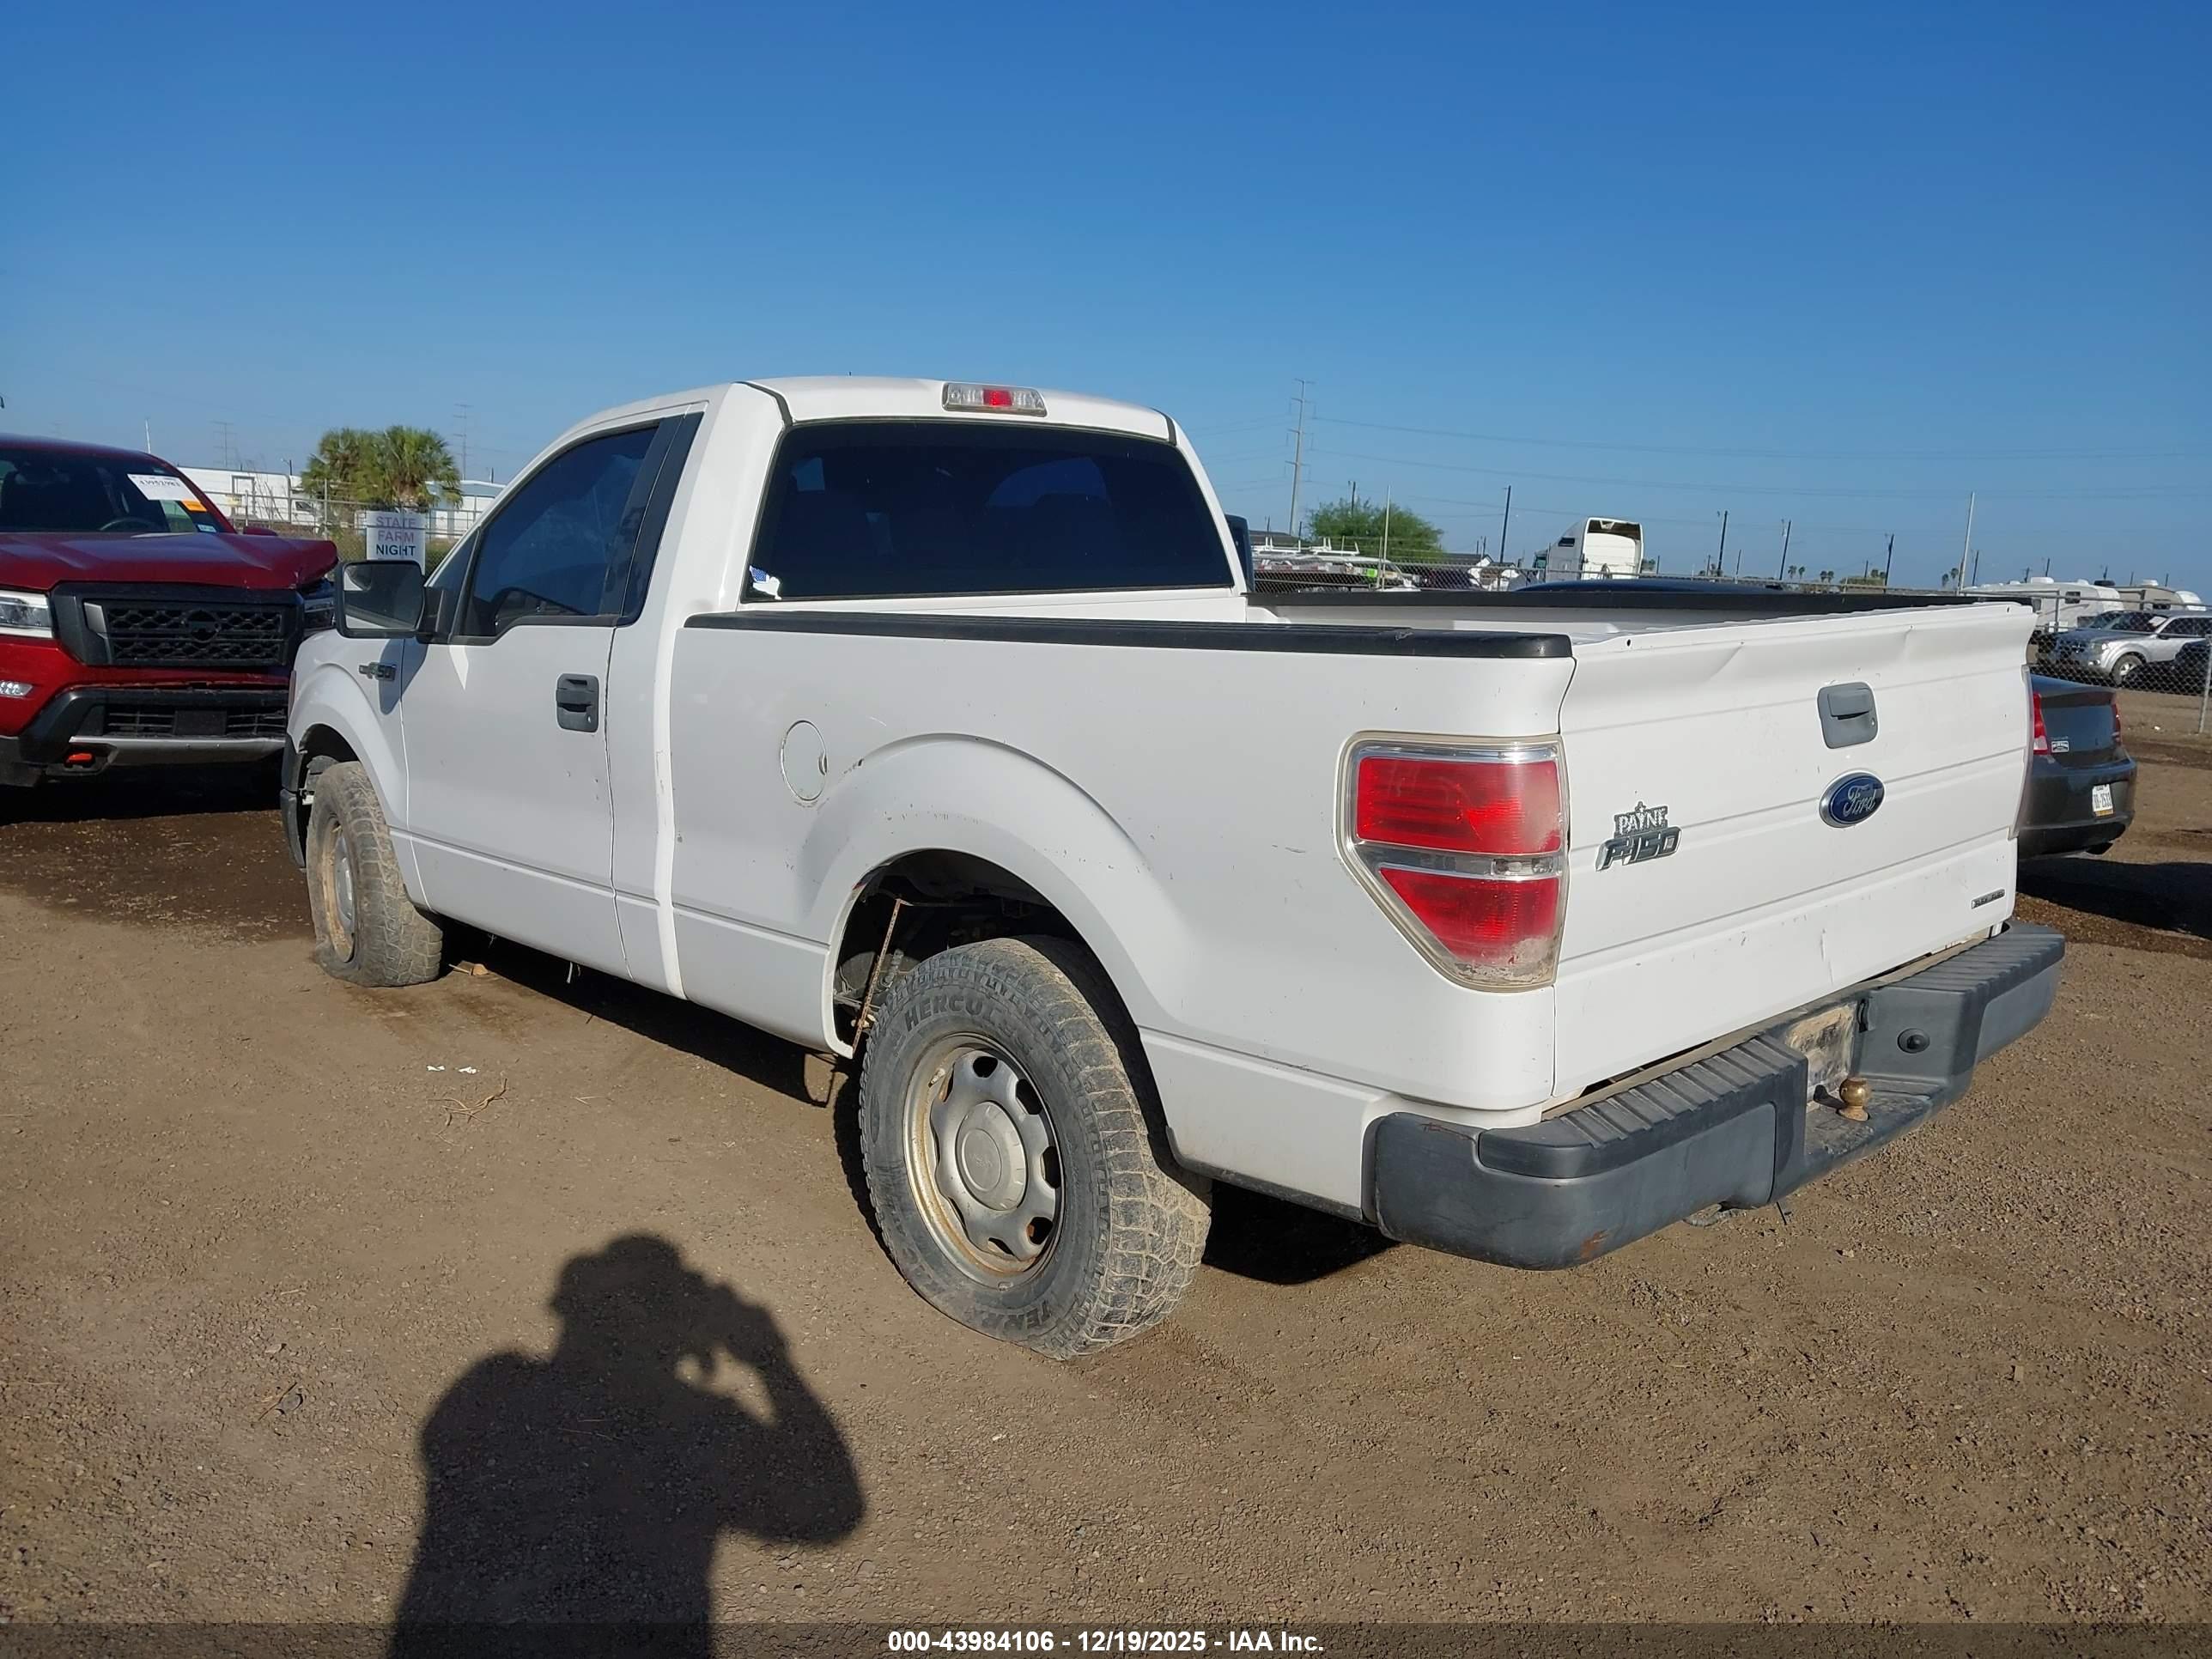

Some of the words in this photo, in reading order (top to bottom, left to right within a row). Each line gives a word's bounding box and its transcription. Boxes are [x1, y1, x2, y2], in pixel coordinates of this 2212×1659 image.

[375, 515, 416, 529] STATE
[377, 530, 415, 543] FARM
[375, 544, 416, 556] NIGHT
[1843, 784, 1878, 817] Ford
[1595, 825, 1683, 872] F-150
